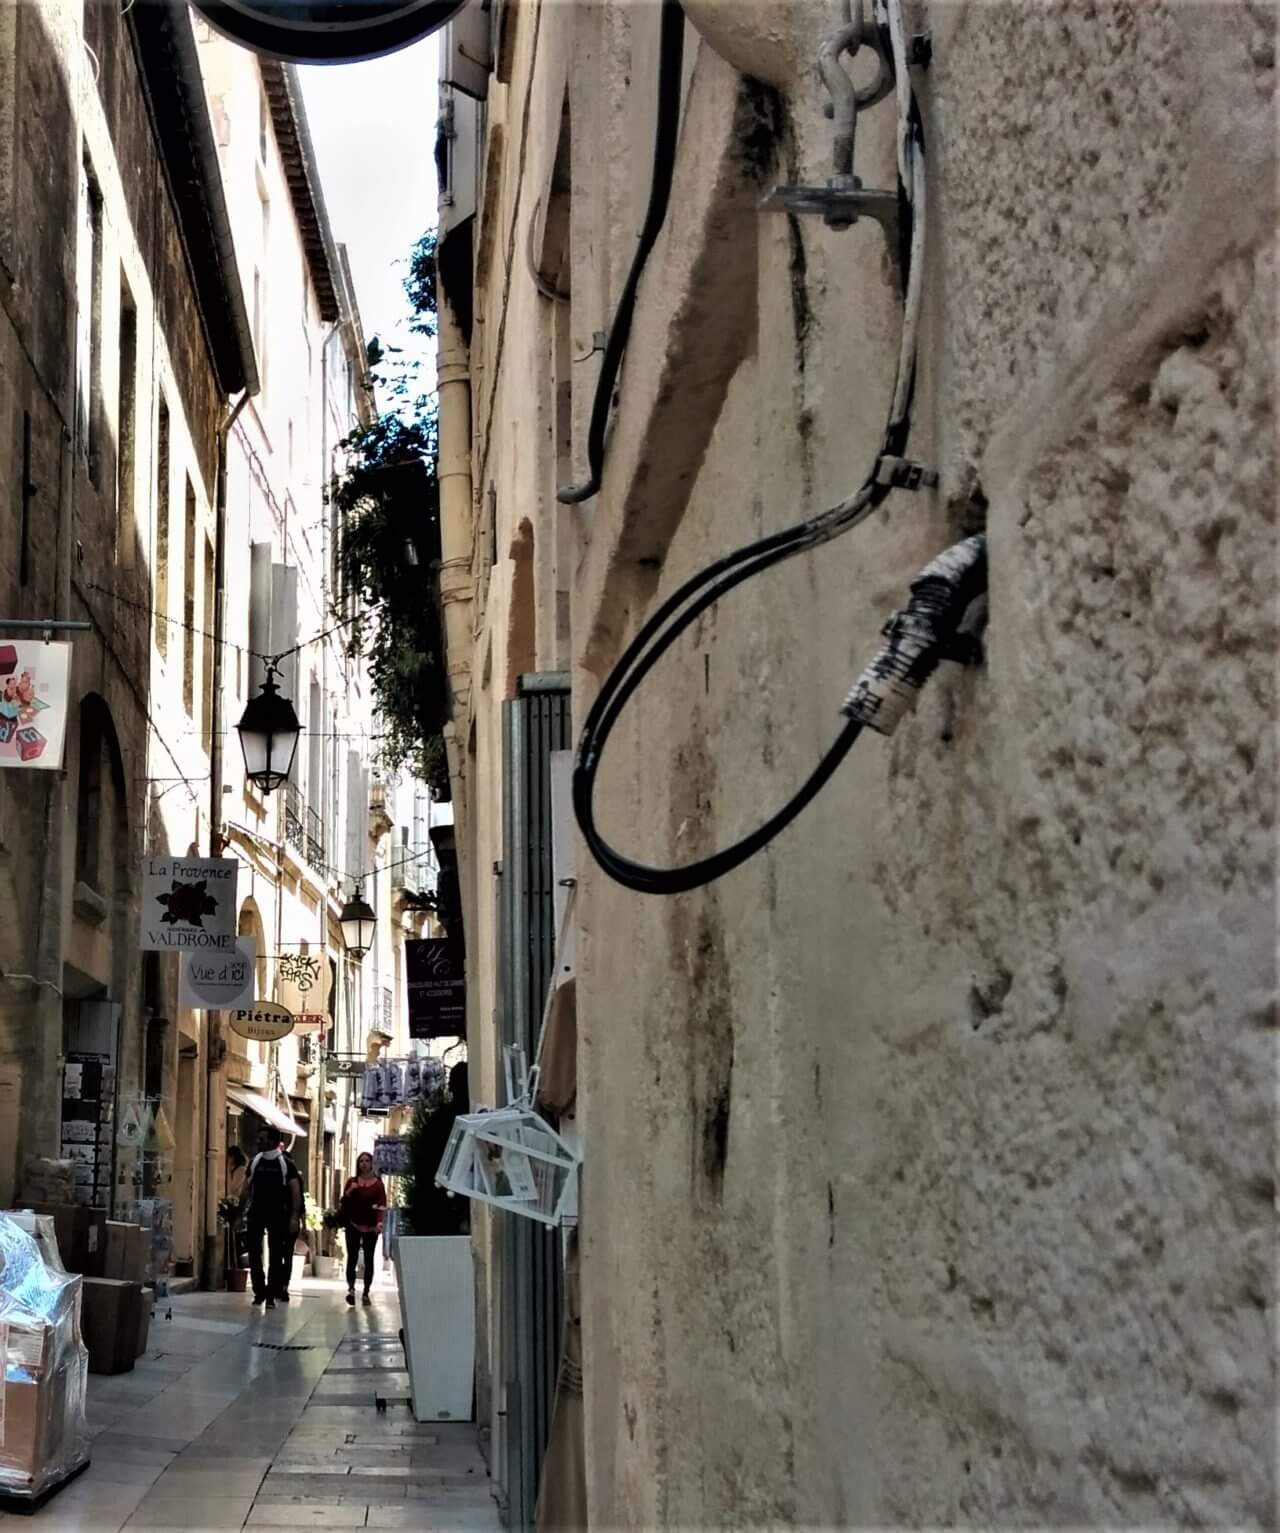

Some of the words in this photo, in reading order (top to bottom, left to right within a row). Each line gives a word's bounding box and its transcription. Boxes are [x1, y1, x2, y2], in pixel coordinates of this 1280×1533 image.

[149, 861, 166, 876] La
[172, 862, 232, 880] Provence
[148, 928, 231, 948] VALDRÔME
[191, 964, 215, 981] Vue
[236, 1010, 290, 1023] Piétra
